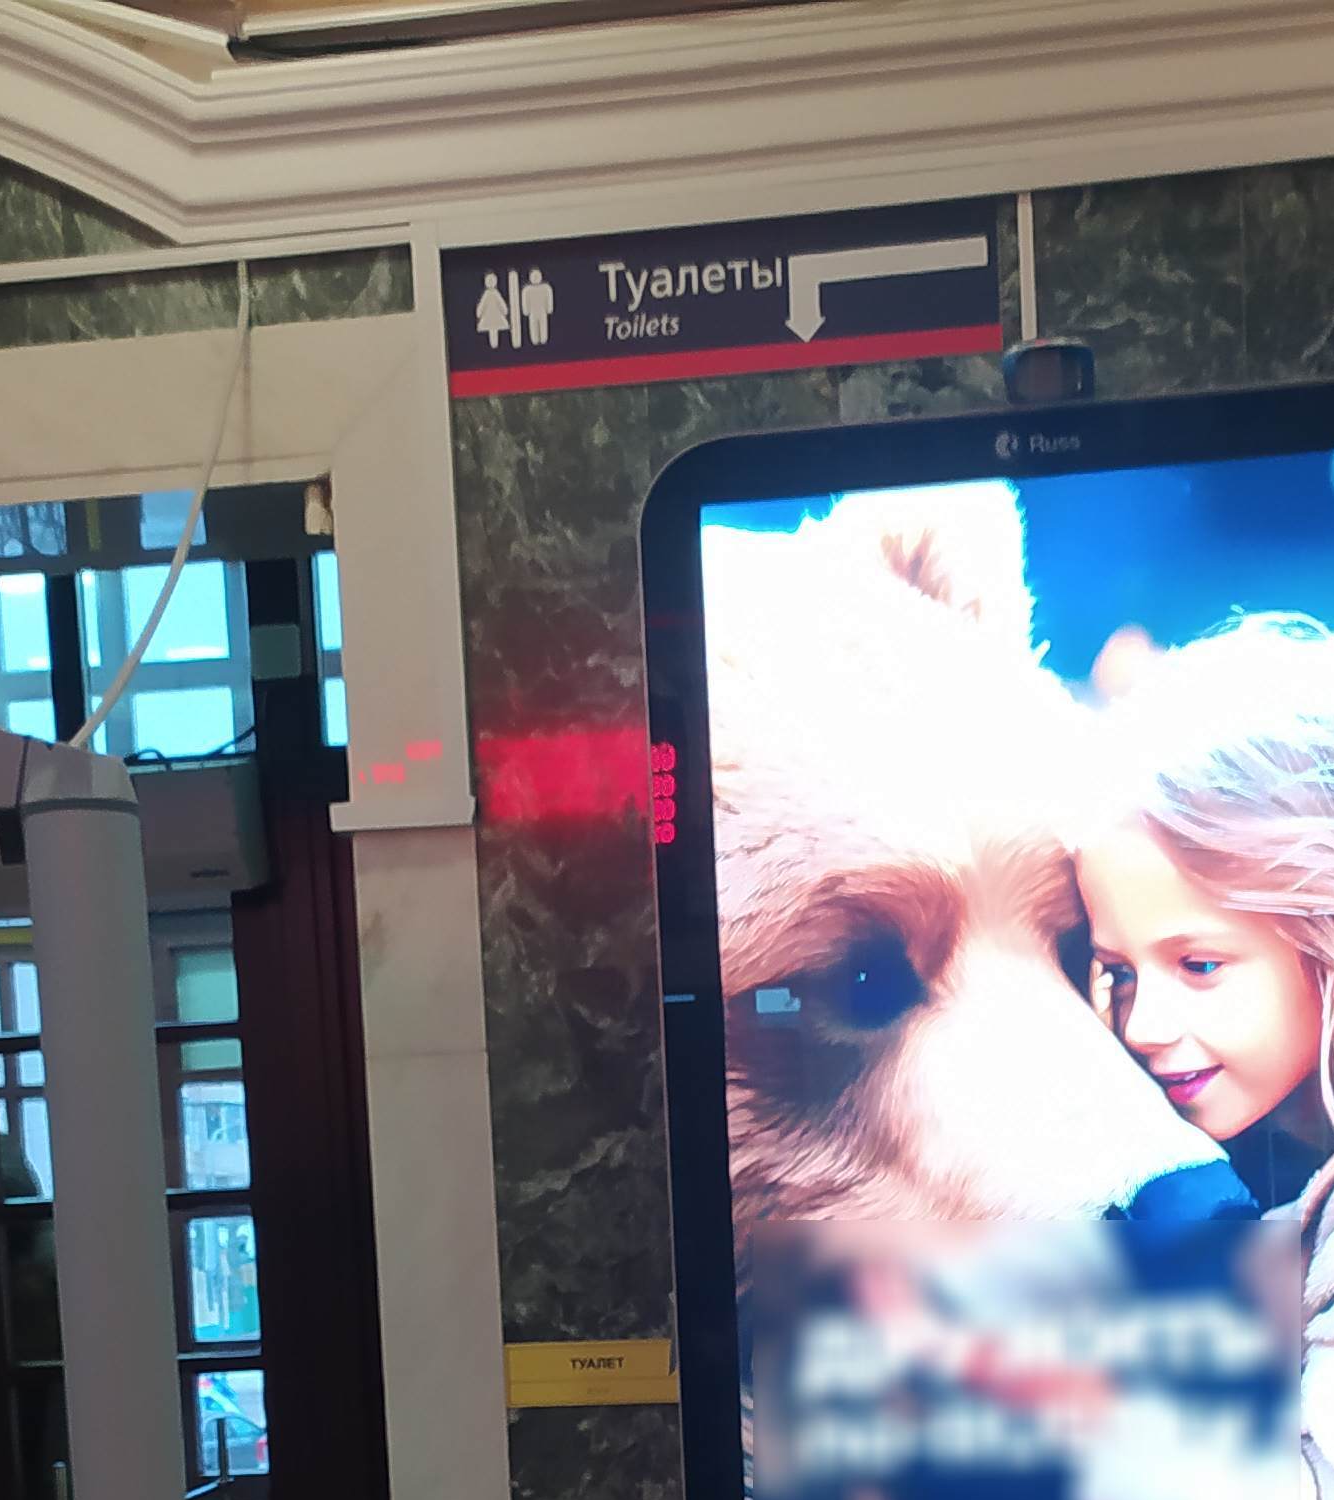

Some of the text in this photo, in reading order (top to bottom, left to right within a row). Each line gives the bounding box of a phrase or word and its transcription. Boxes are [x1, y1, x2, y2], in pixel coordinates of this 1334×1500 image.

[598, 256, 783, 312] Туалеты
[604, 313, 681, 341] Toilets
[570, 1357, 625, 1370] ТУАЛЕТ
